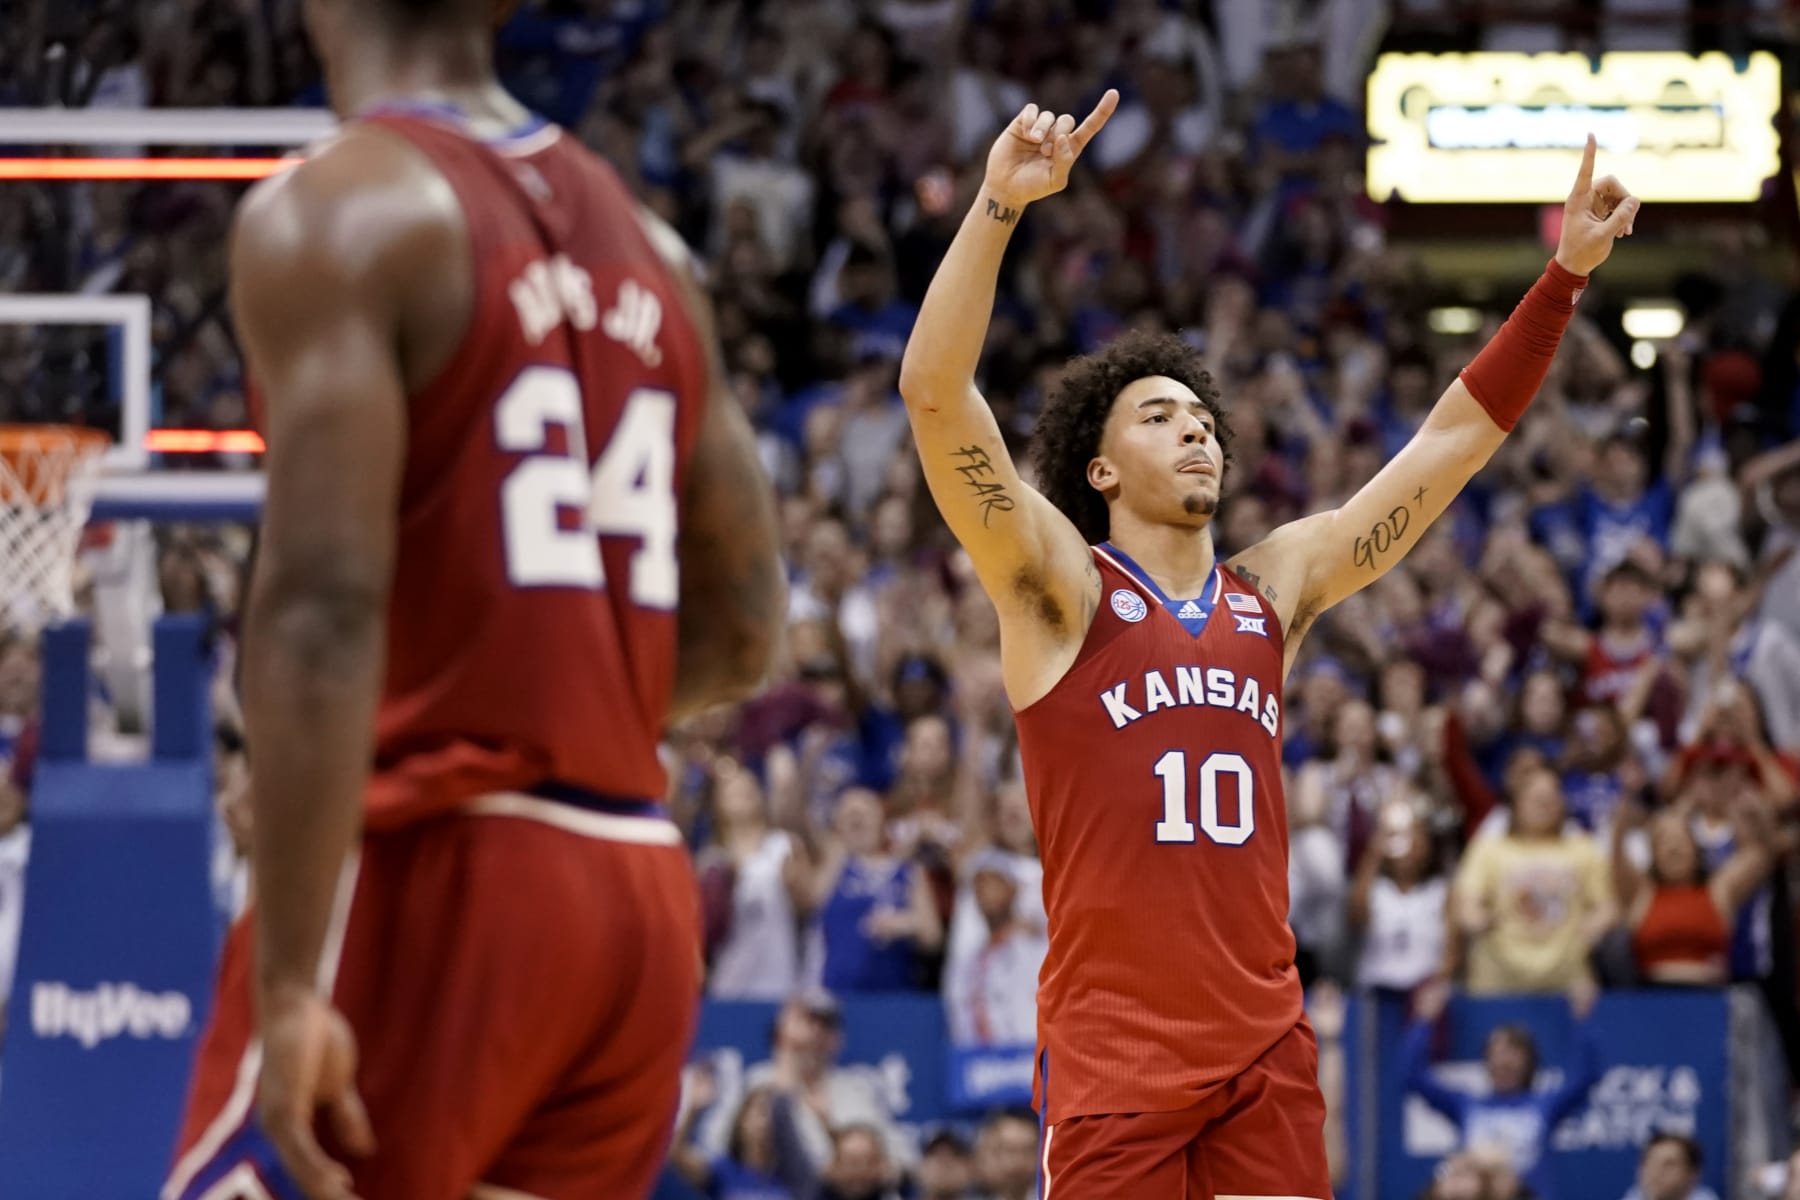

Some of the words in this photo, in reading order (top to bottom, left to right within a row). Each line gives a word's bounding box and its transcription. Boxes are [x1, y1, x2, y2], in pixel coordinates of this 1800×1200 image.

[495, 364, 680, 612] 24
[947, 445, 1015, 529] FEAR
[1354, 506, 1410, 570] GOD
[1100, 665, 1280, 738] KANSAS
[1152, 749, 1256, 845] 10
